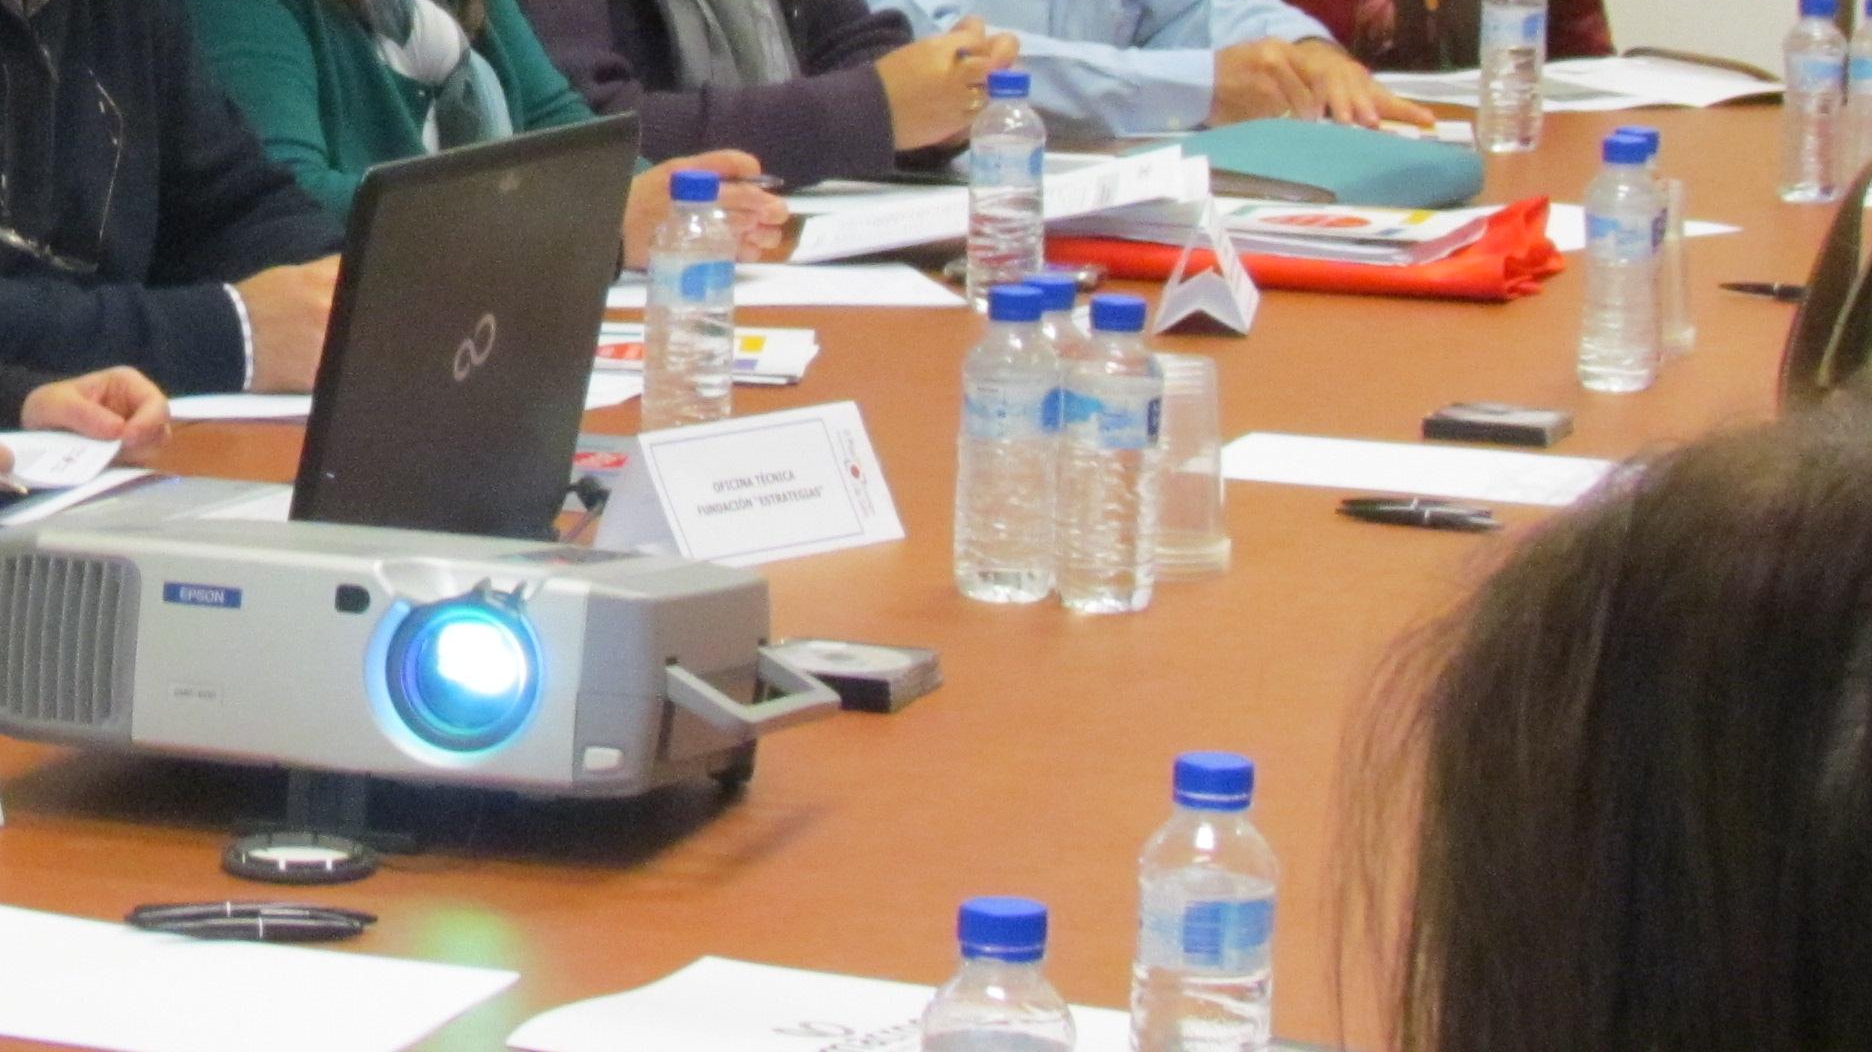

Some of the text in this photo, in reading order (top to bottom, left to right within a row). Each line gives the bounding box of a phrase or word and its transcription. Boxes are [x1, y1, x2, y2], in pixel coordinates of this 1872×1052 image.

[712, 469, 796, 493] OFICINA TÉCNICA
[179, 586, 225, 605] EPSON
